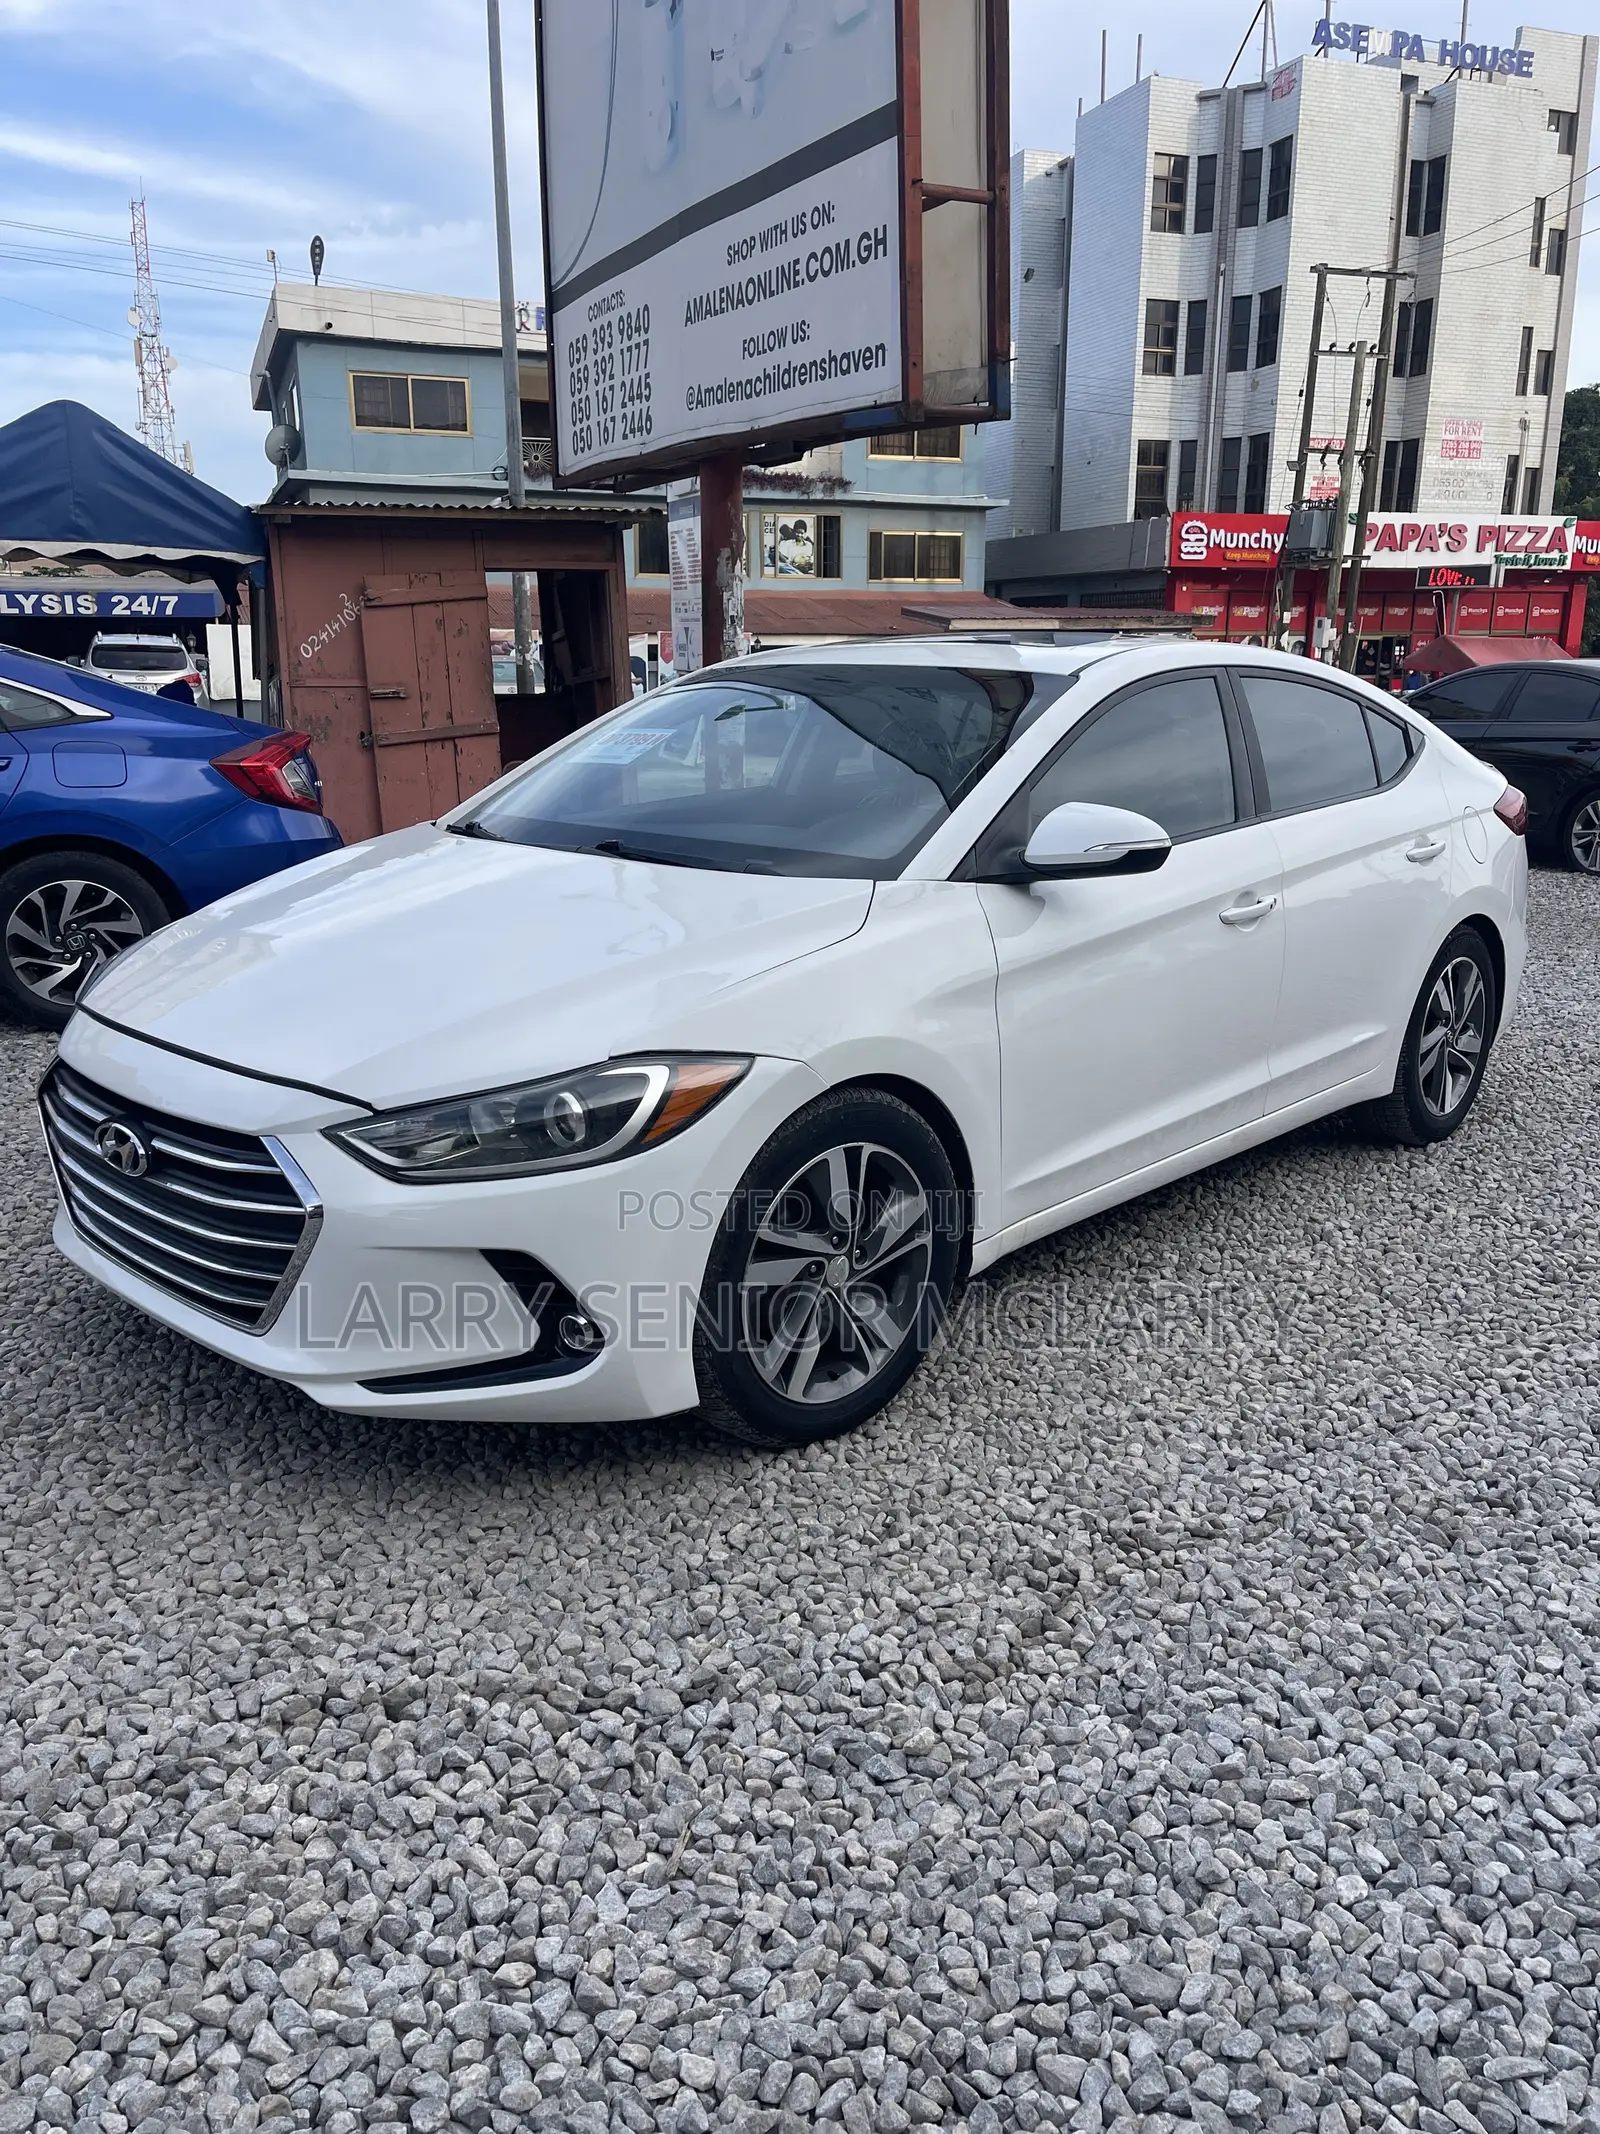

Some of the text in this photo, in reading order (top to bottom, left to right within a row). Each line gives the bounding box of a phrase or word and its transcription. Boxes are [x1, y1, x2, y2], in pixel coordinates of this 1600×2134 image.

[1311, 18, 1535, 78] ASEMPA HOUSE
[726, 200, 835, 266] SHOP WITH US ON:
[684, 223, 888, 328] AMALENAONLINE.COM.GH
[588, 289, 626, 323] CONTACTS:
[568, 303, 650, 369] 059 393 9840
[742, 319, 810, 360] FOLLOW US:
[569, 338, 650, 398] 059 392 1777
[685, 342, 886, 411] @Amalenachildrenshaven
[571, 371, 652, 428] 050 167 2445
[572, 405, 653, 456] 050 167 2446
[1444, 427, 1481, 437] FOR RENT
[1209, 528, 1288, 554] Munchy
[1226, 552, 1270, 562] Keep Munching
[1476, 524, 1569, 554] PIZZA
[1428, 567, 1462, 586] LOVE
[0, 593, 179, 616] LYSIS 24/7
